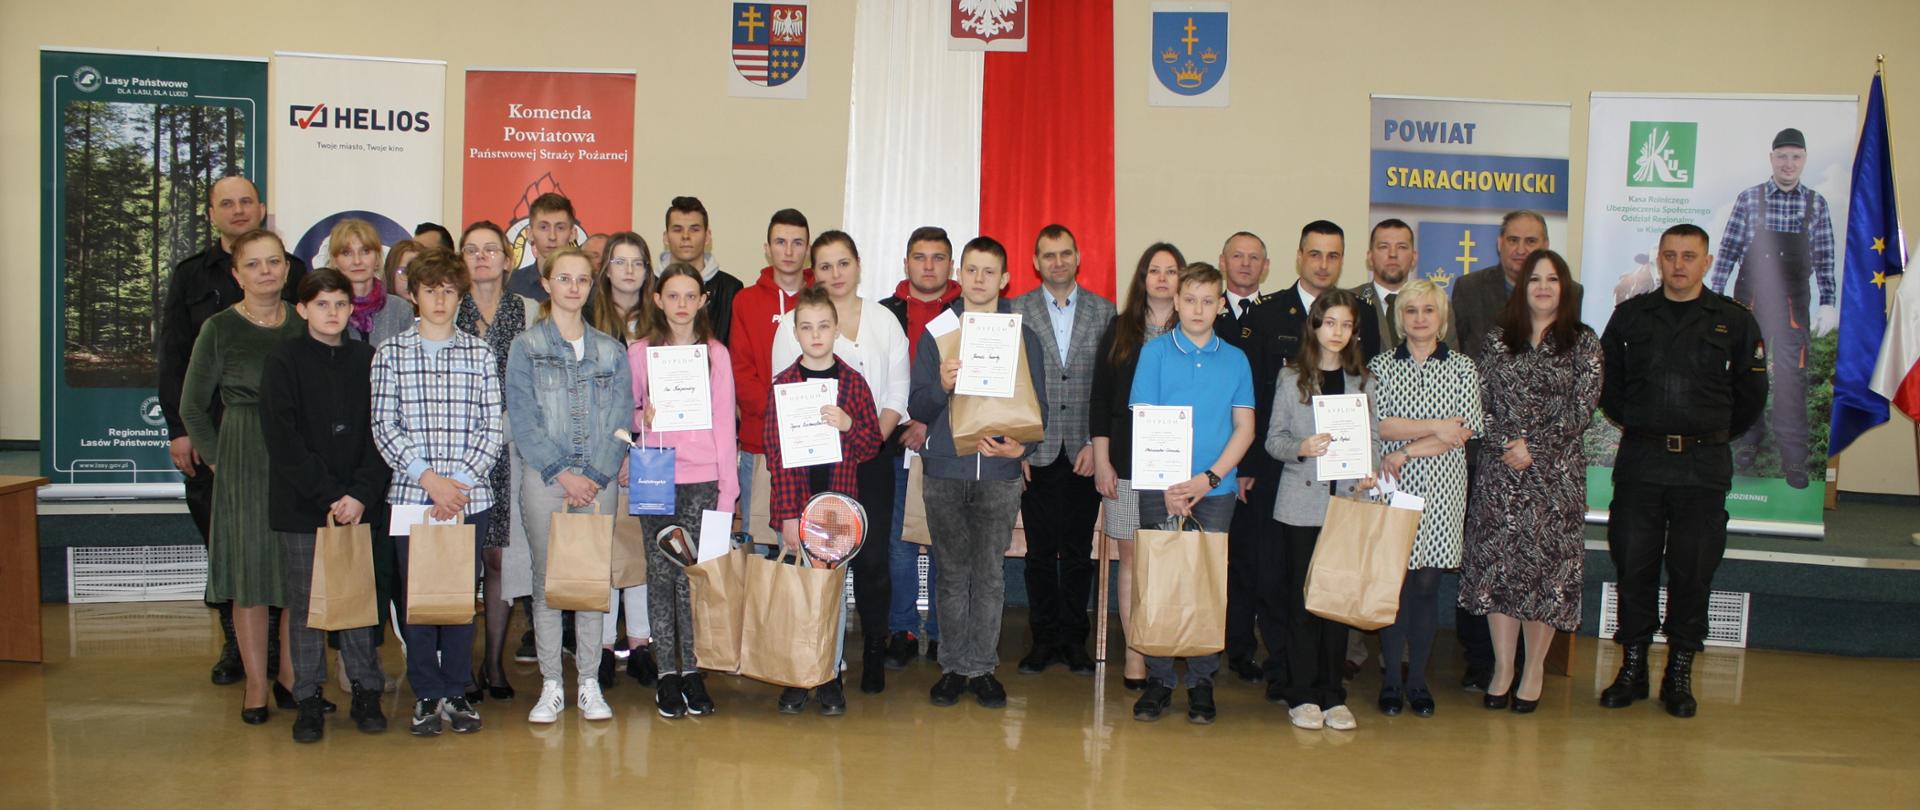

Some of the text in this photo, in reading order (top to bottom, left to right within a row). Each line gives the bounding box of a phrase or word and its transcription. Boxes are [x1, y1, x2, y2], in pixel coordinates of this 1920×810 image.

[105, 76, 129, 88] Lasy
[132, 77, 188, 89] Państwowe
[508, 103, 592, 120] Komenda
[334, 107, 430, 133] HELIOS
[503, 126, 596, 143] Powiatowa
[1384, 119, 1477, 145] POWIAT
[317, 141, 404, 153] Twoje miasto, Twoje kino
[469, 147, 628, 163] Państwowej Straży Pożarnej
[1386, 166, 1556, 194] STARACHOWICKI
[1628, 195, 1690, 205] Kasa Rolniczego
[1606, 204, 1711, 216] Ubezpieczenia Społecznego
[1652, 215, 1695, 225] Regionalny
[1645, 226, 1666, 234] Kielc
[108, 428, 159, 438] Regionalna
[81, 438, 171, 448] Lasów Państwowyc
